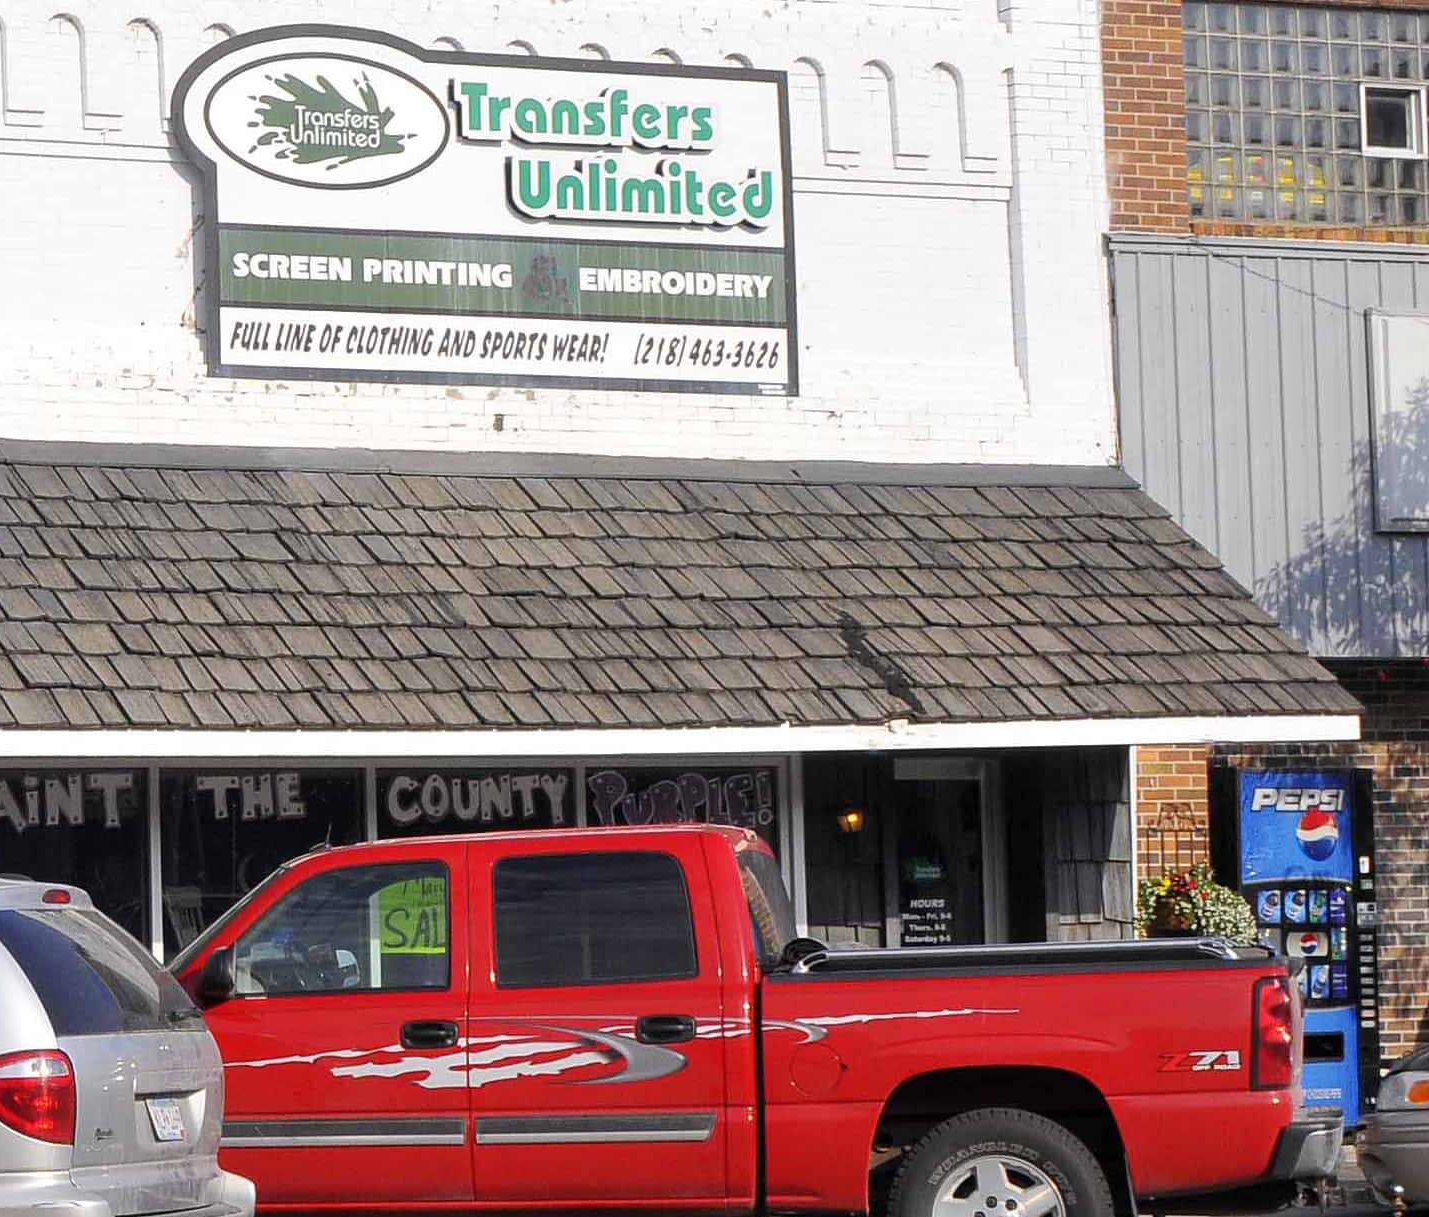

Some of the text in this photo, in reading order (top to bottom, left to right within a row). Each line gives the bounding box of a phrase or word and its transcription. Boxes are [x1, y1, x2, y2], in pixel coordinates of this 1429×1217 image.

[294, 105, 380, 130] Transfers
[459, 81, 714, 142] Transfers
[290, 123, 381, 149] Unlimited
[518, 158, 773, 219] Unlimited
[232, 252, 352, 282] SCREEN
[363, 258, 513, 289] PRINTING
[579, 267, 774, 298] EMBROIDERY
[230, 321, 272, 351] FULL
[275, 323, 316, 352] LINE
[318, 323, 343, 353] OF
[346, 326, 435, 357] CLOTHING
[437, 328, 476, 359] AND
[478, 330, 548, 361] SPORTS
[552, 333, 609, 364] WEAR!
[196, 773, 307, 820] THE
[388, 772, 568, 825] COUNTY
[1251, 788, 1345, 812] PEPSI
[910, 898, 945, 909] HOURS
[383, 907, 446, 949] SAL
[1158, 1051, 1240, 1072] Z71
